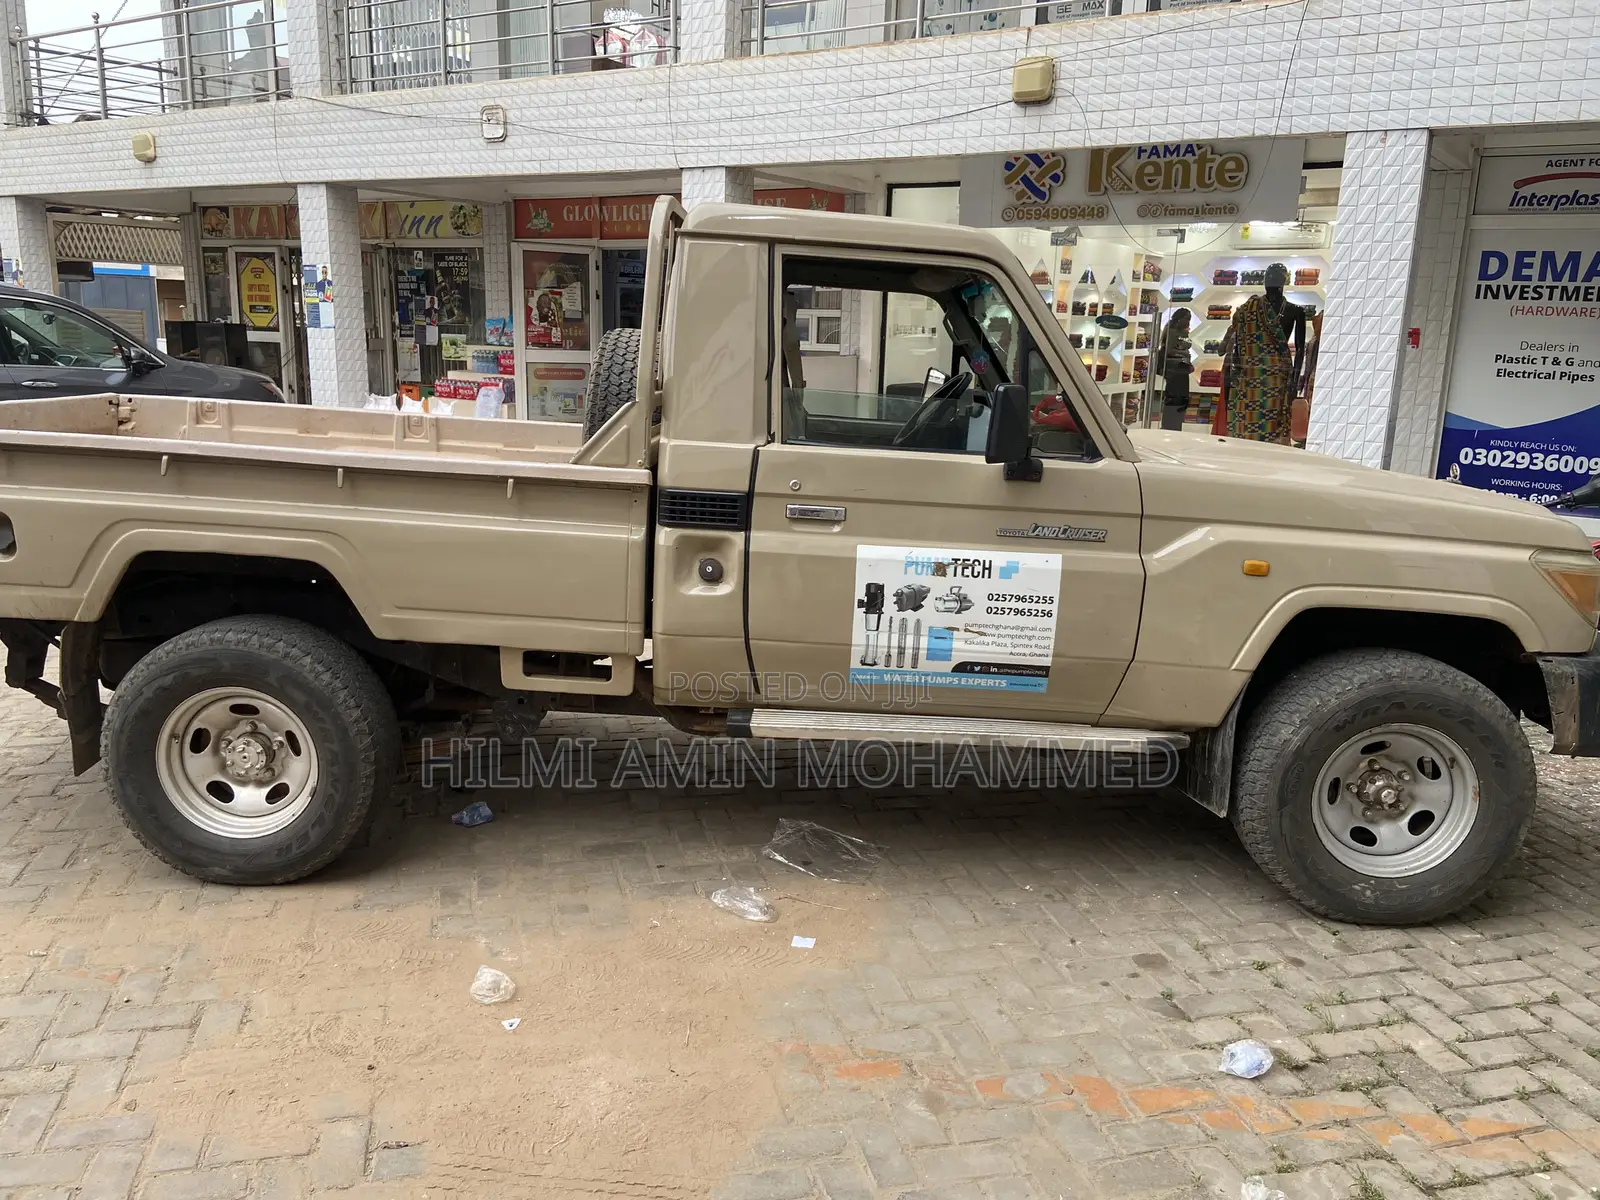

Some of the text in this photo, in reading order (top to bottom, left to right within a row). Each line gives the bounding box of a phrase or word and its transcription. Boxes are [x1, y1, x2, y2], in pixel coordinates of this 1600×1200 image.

[1546, 159, 1586, 168] AGENT
[1087, 148, 1247, 193] Kente
[1016, 207, 1106, 221] 0594909448
[400, 202, 444, 239] inn
[1520, 341, 1580, 352] Dealers in
[1495, 354, 1537, 365] Plastic
[1540, 356, 1549, 365] T
[1551, 357, 1561, 366] &
[1565, 357, 1575, 366] G
[1496, 368, 1596, 384] Electrical Pipes
[1490, 440, 1519, 448] KINDLY
[1520, 441, 1547, 450] REACH
[1561, 444, 1577, 452] ON:
[1491, 479, 1563, 491] WORKING HOURS:
[987, 593, 1055, 605] 0257965255
[986, 606, 1053, 618] 0257965256
[884, 673, 919, 683] WATER
[921, 675, 959, 685] PUMPS
[961, 677, 1007, 687] EXPERTS
